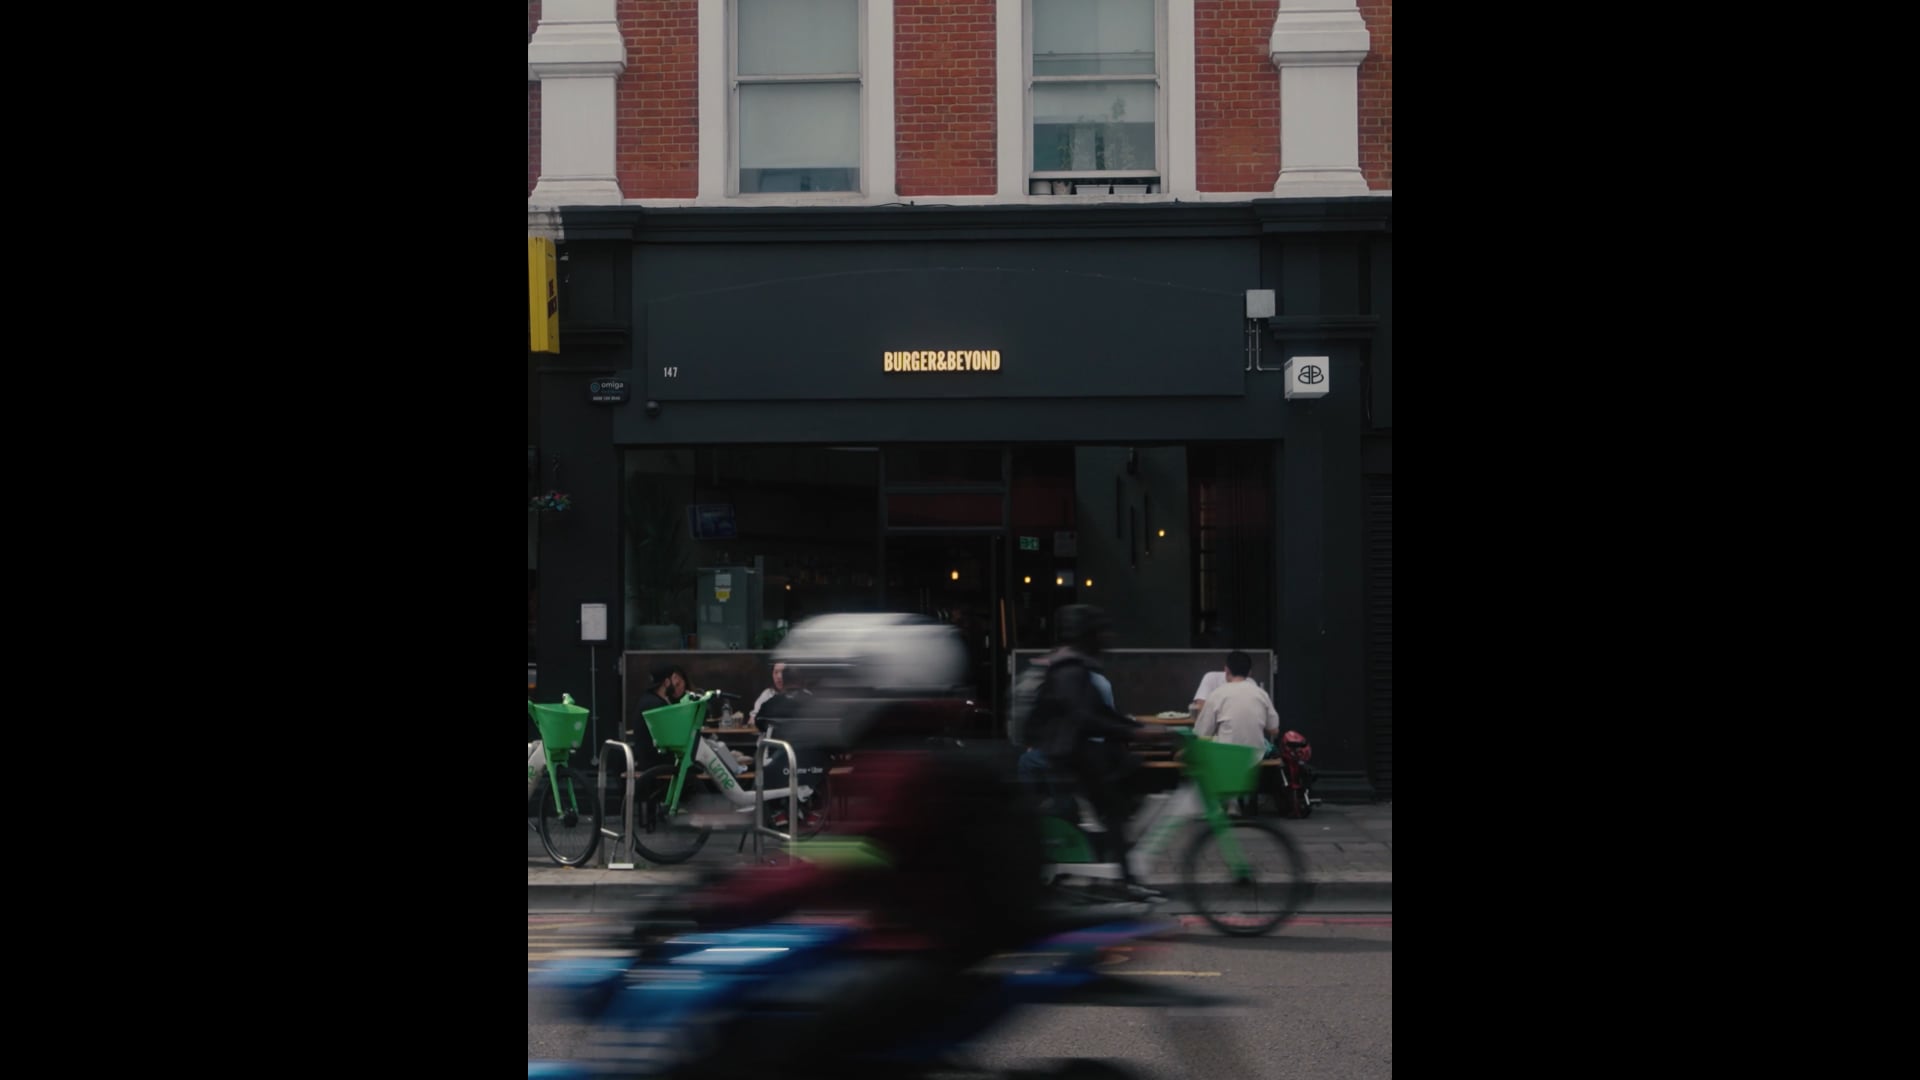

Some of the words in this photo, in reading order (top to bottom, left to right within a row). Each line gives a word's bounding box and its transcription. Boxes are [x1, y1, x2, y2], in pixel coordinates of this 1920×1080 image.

[884, 350, 1001, 371] BURGER&BEYOND
[663, 366, 678, 378] 147
[601, 381, 624, 390] omiga
